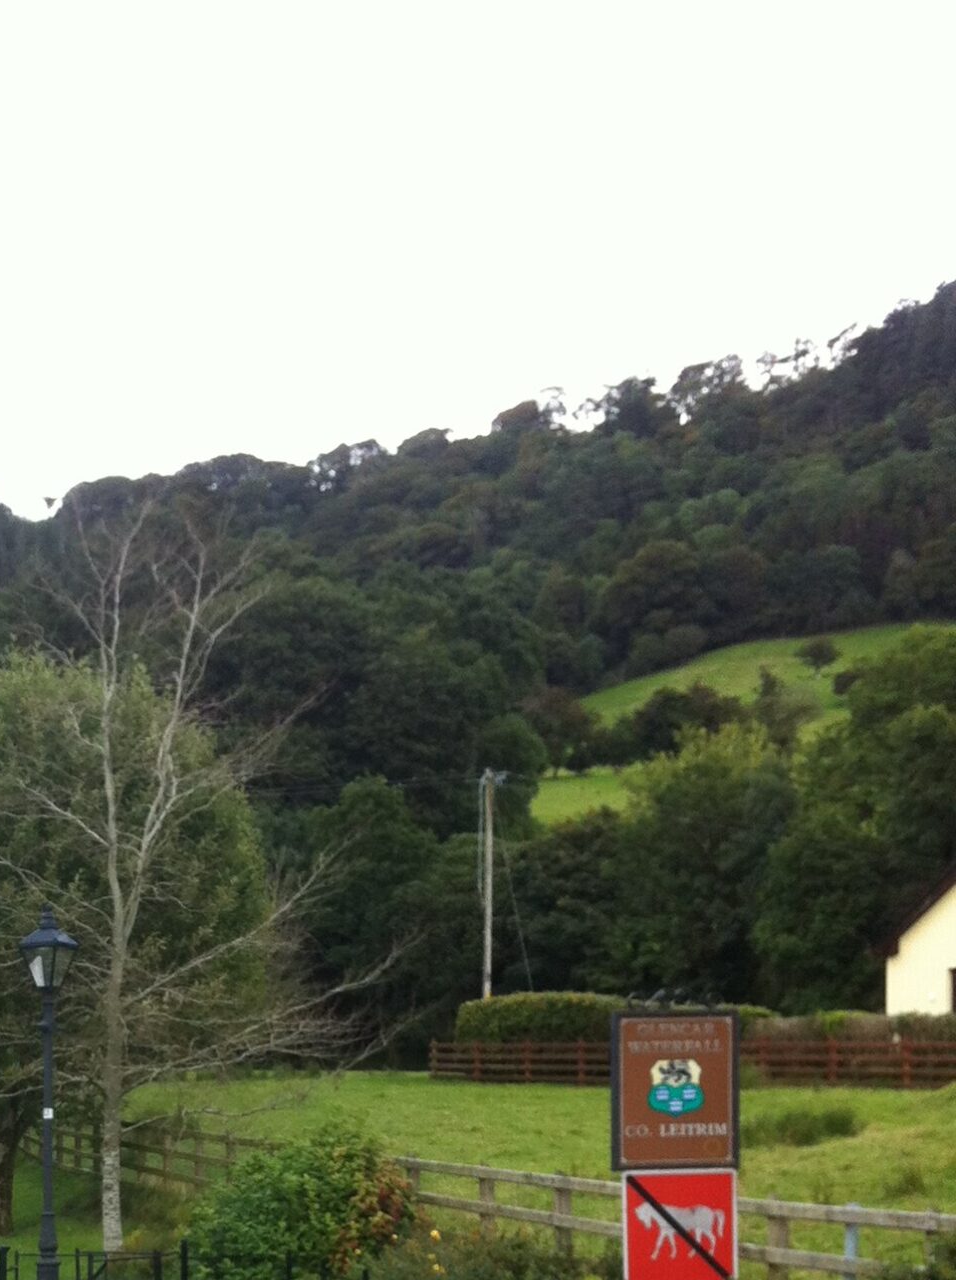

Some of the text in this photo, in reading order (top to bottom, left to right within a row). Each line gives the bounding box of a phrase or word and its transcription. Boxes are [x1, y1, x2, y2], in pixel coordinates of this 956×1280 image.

[636, 1023, 715, 1036] GLENCAR
[627, 1039, 723, 1053] WATERFALL
[659, 1122, 728, 1137] LEITRIM
